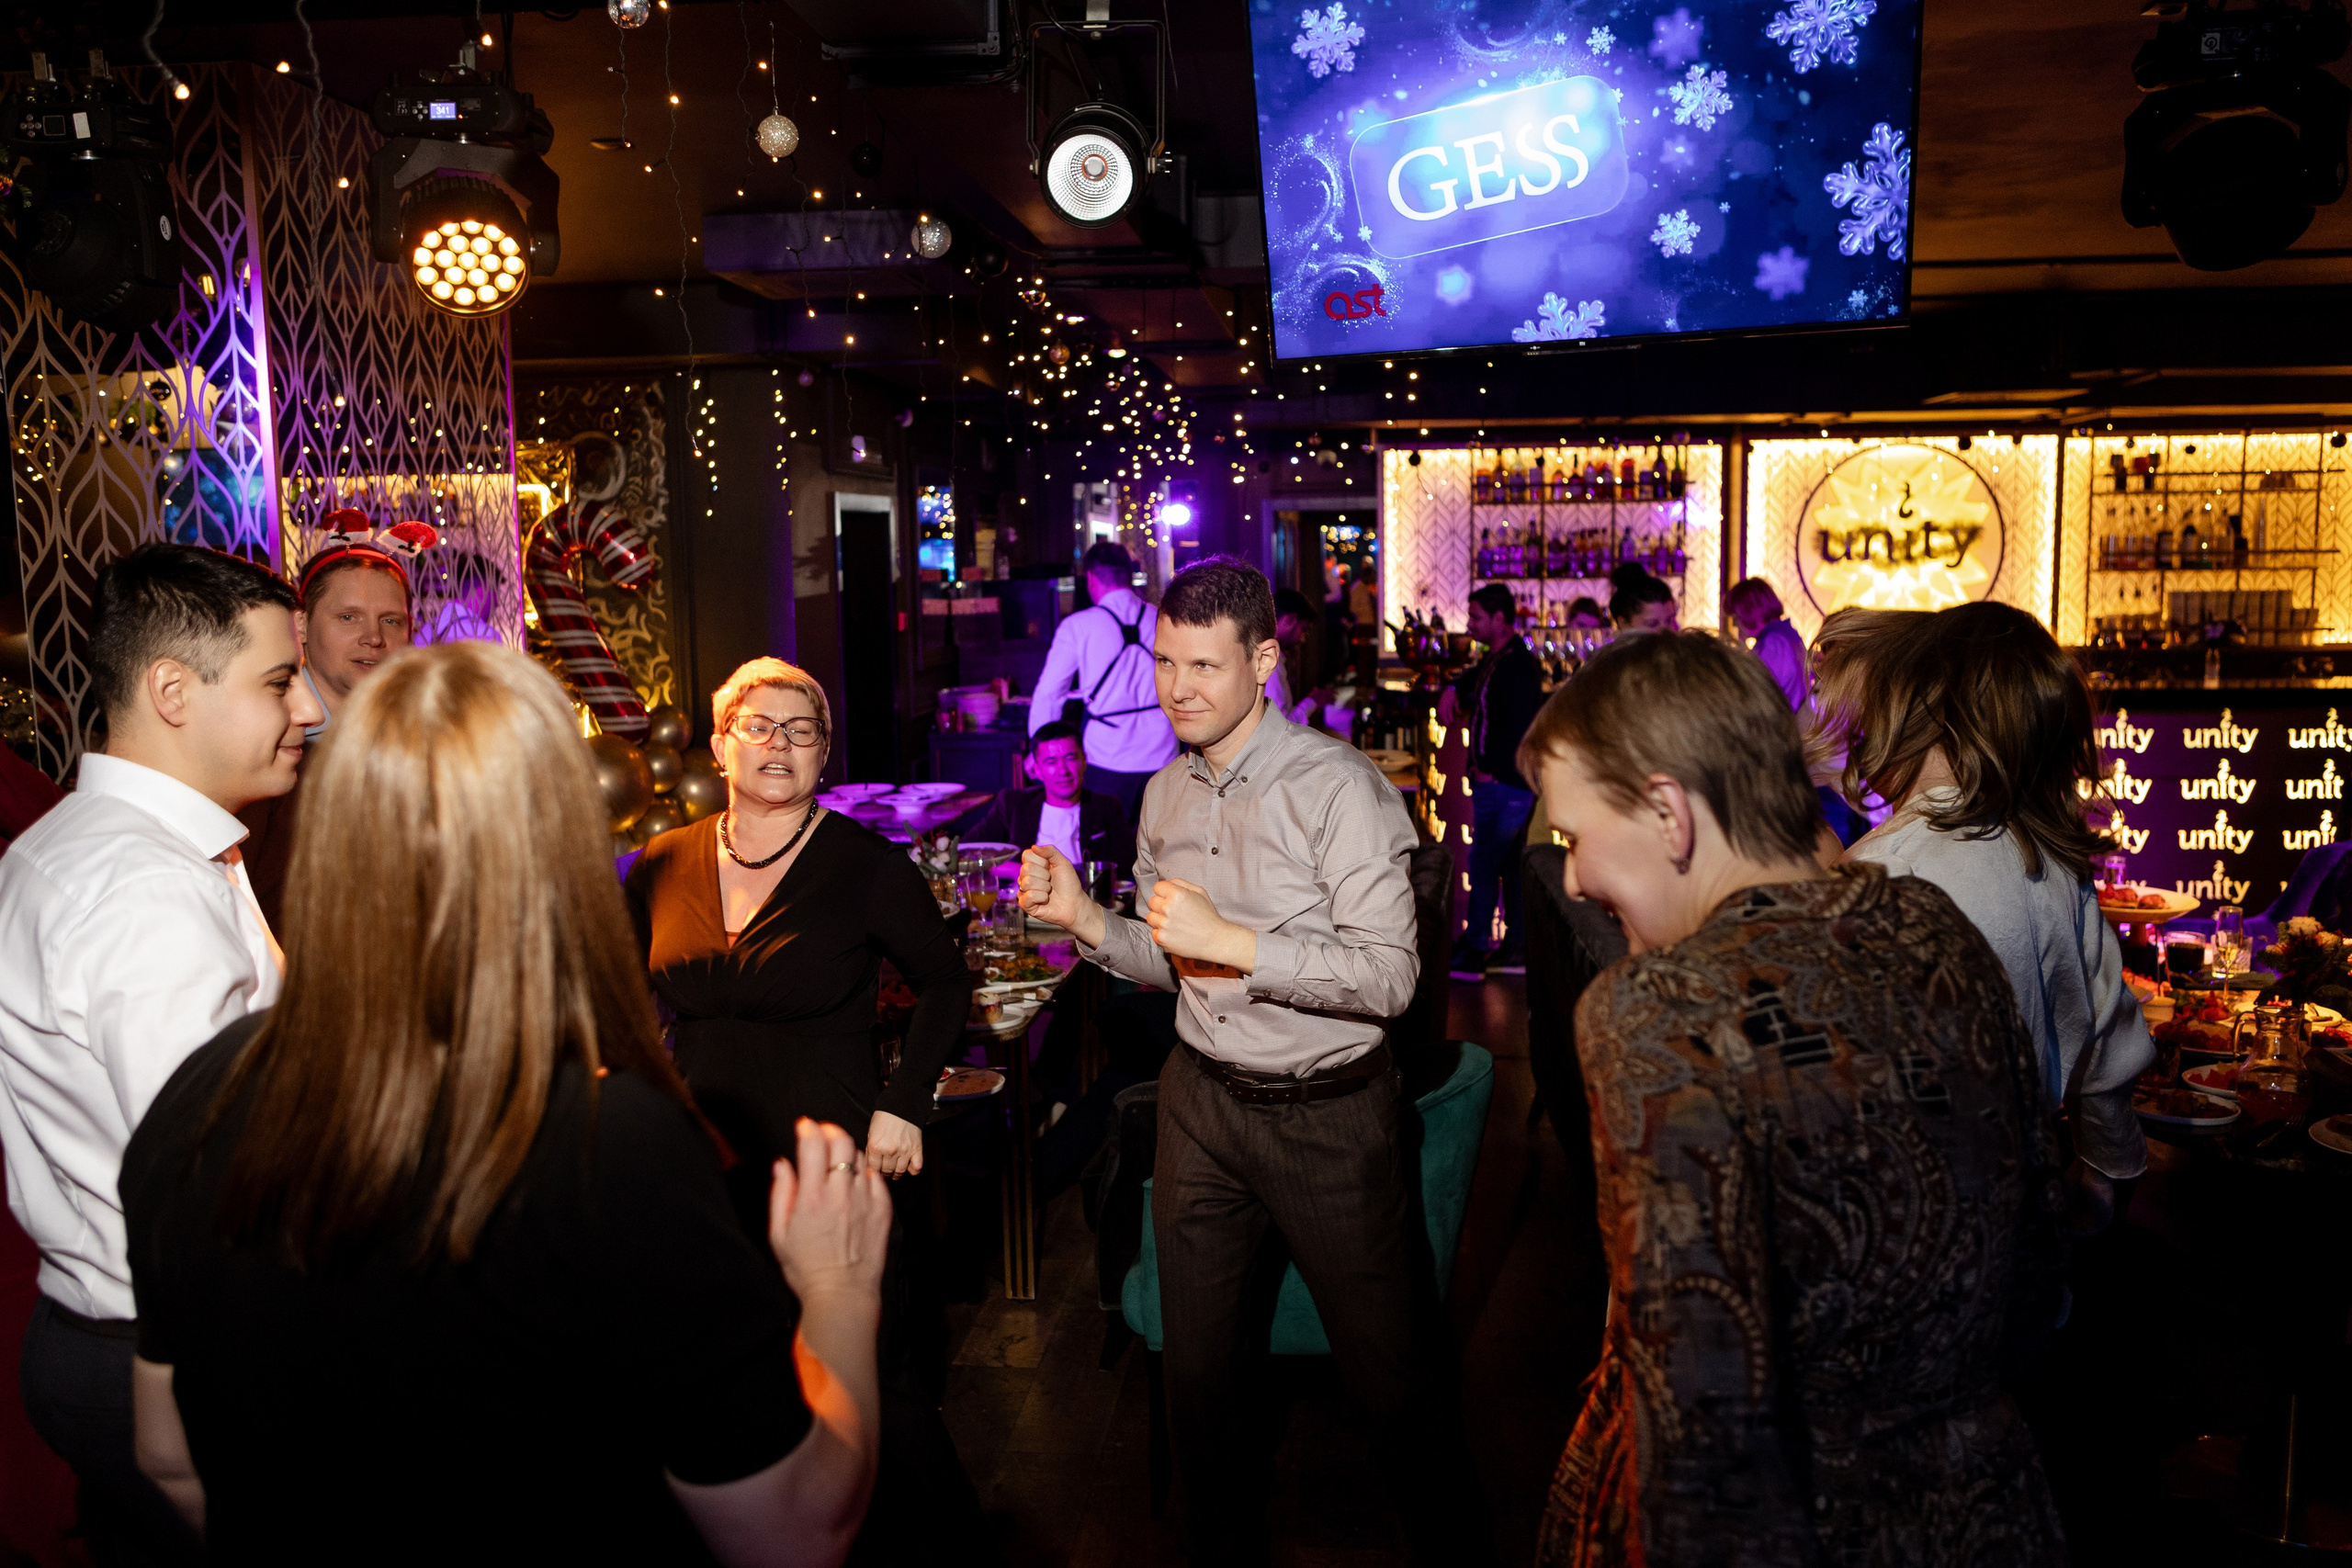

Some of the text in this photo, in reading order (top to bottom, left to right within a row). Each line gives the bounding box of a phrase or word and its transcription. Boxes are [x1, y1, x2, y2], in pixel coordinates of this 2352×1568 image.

[435, 106, 449, 115] 341
[1386, 114, 1590, 221] GESS
[1324, 283, 1387, 321] ast
[1816, 492, 1983, 568] unity
[2182, 707, 2259, 753] unity
[2180, 758, 2256, 805] unity
[2285, 758, 2345, 800] unit
[2178, 809, 2254, 854] unity
[2176, 860, 2251, 905] unity
